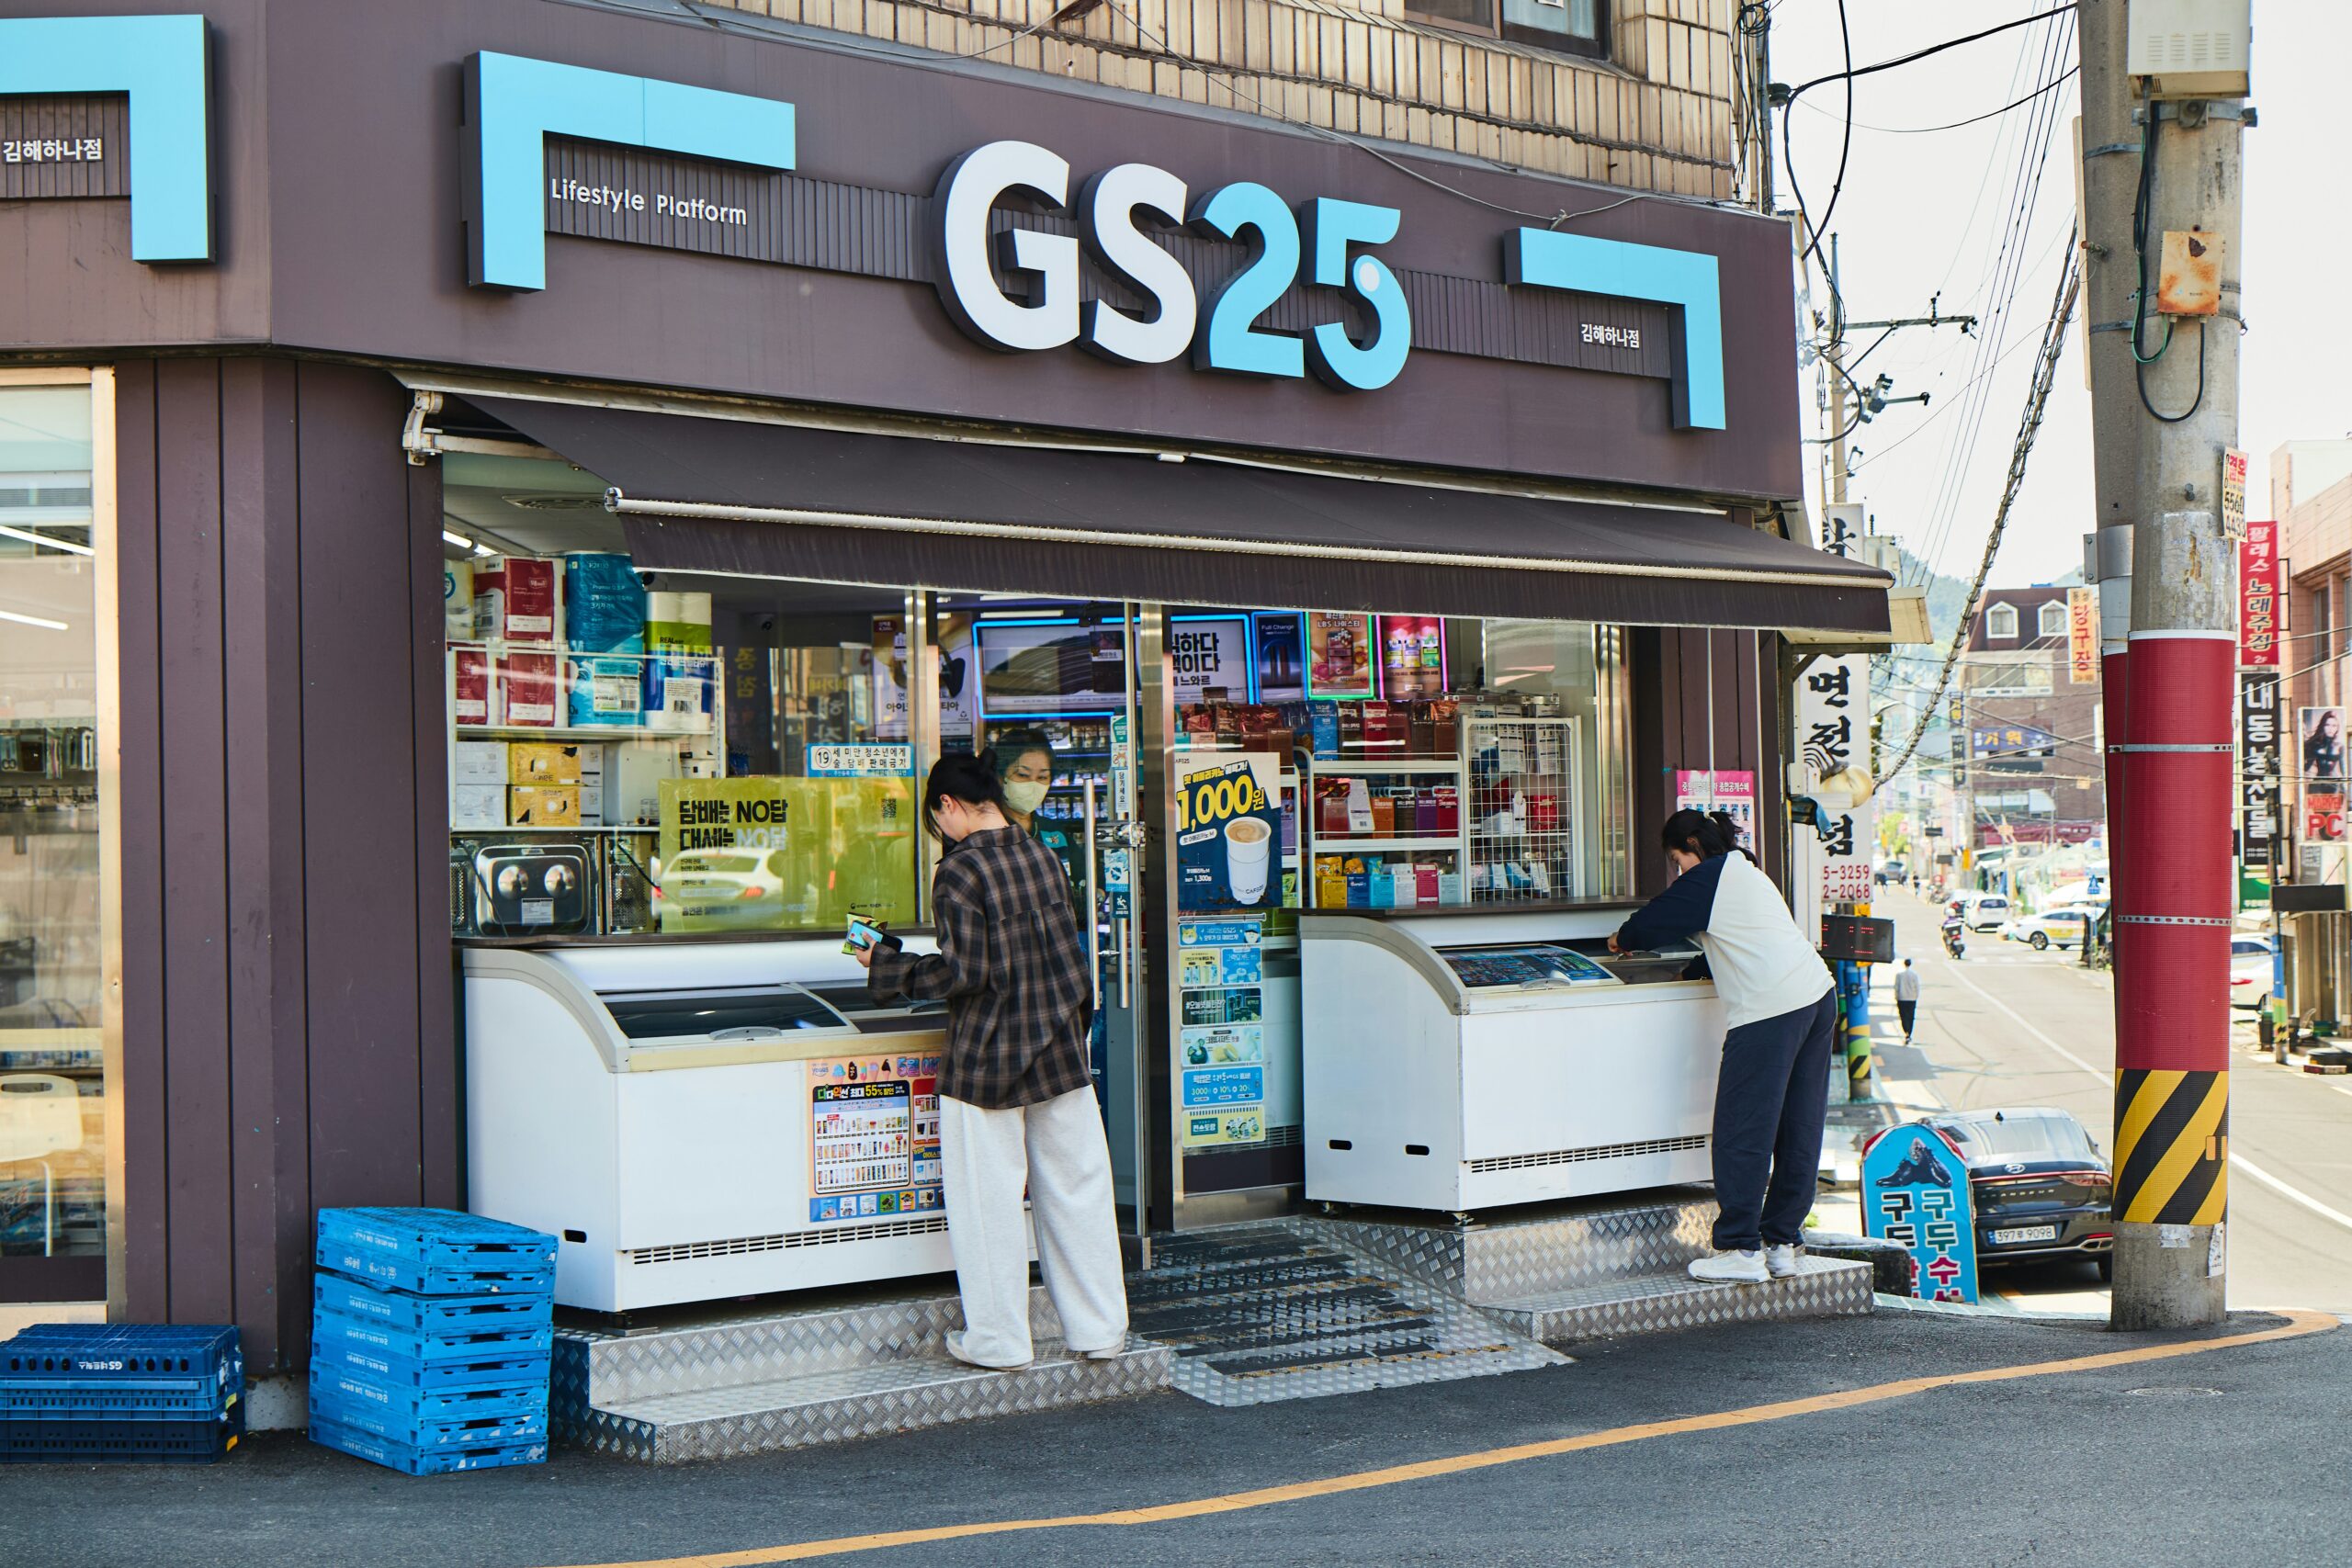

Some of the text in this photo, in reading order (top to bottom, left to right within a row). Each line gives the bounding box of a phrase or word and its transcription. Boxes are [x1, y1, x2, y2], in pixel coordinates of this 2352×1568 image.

[3, 138, 103, 163] 김해하나점
[551, 178, 747, 226] Lifestyle Platform
[939, 139, 1412, 390] GS25
[1581, 323, 1640, 349] 김해하나점
[2245, 578, 2273, 651] 노래주점
[2253, 655, 2268, 664] 2F
[817, 750, 830, 764] 19
[865, 747, 907, 758] 청소년에게
[869, 758, 907, 769] 판매금지
[679, 800, 730, 825] 담배는
[2307, 794, 2343, 810] MARVEL
[2307, 814, 2343, 839] PC
[865, 1084, 883, 1098] 55%
[2027, 1227, 2052, 1239] 9098
